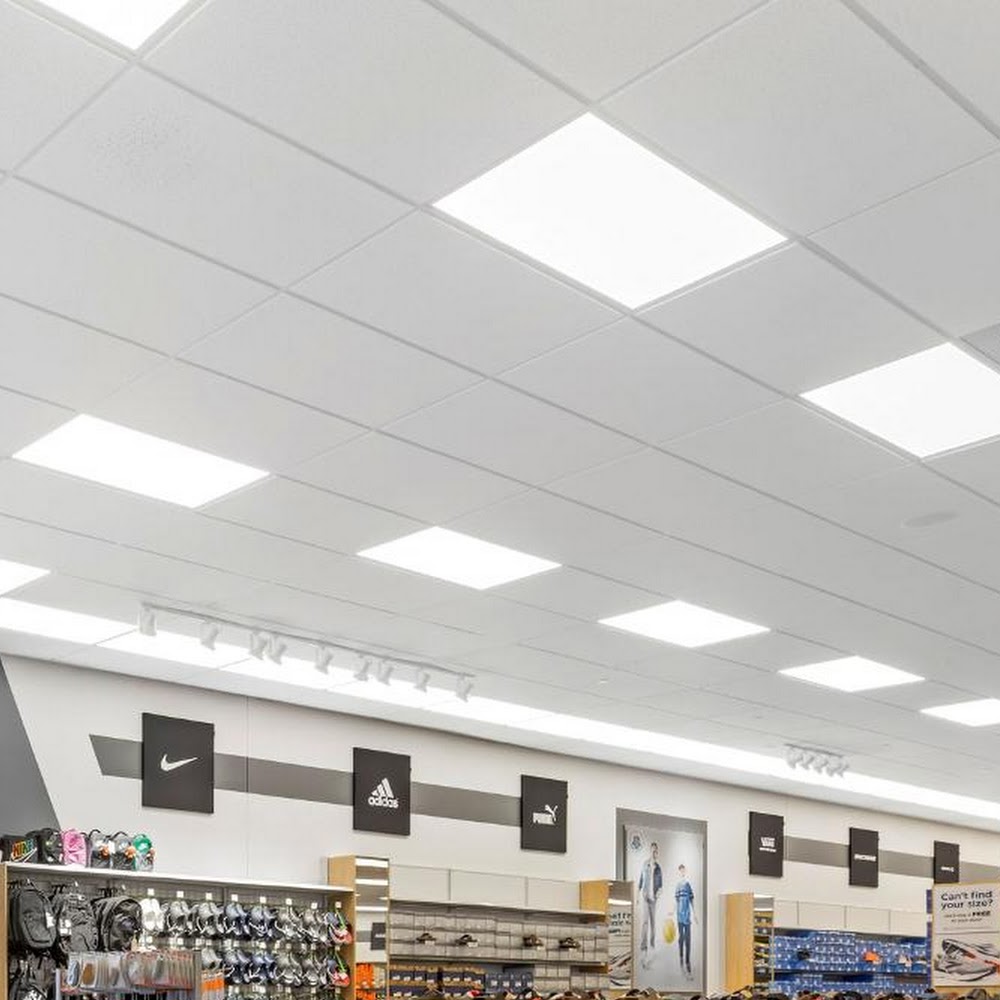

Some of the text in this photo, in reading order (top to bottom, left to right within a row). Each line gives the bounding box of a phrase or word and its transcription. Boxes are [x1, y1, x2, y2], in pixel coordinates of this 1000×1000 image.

[367, 796, 399, 809] adidas
[940, 890, 993, 901] Can't find
[940, 898, 994, 911] your size?
